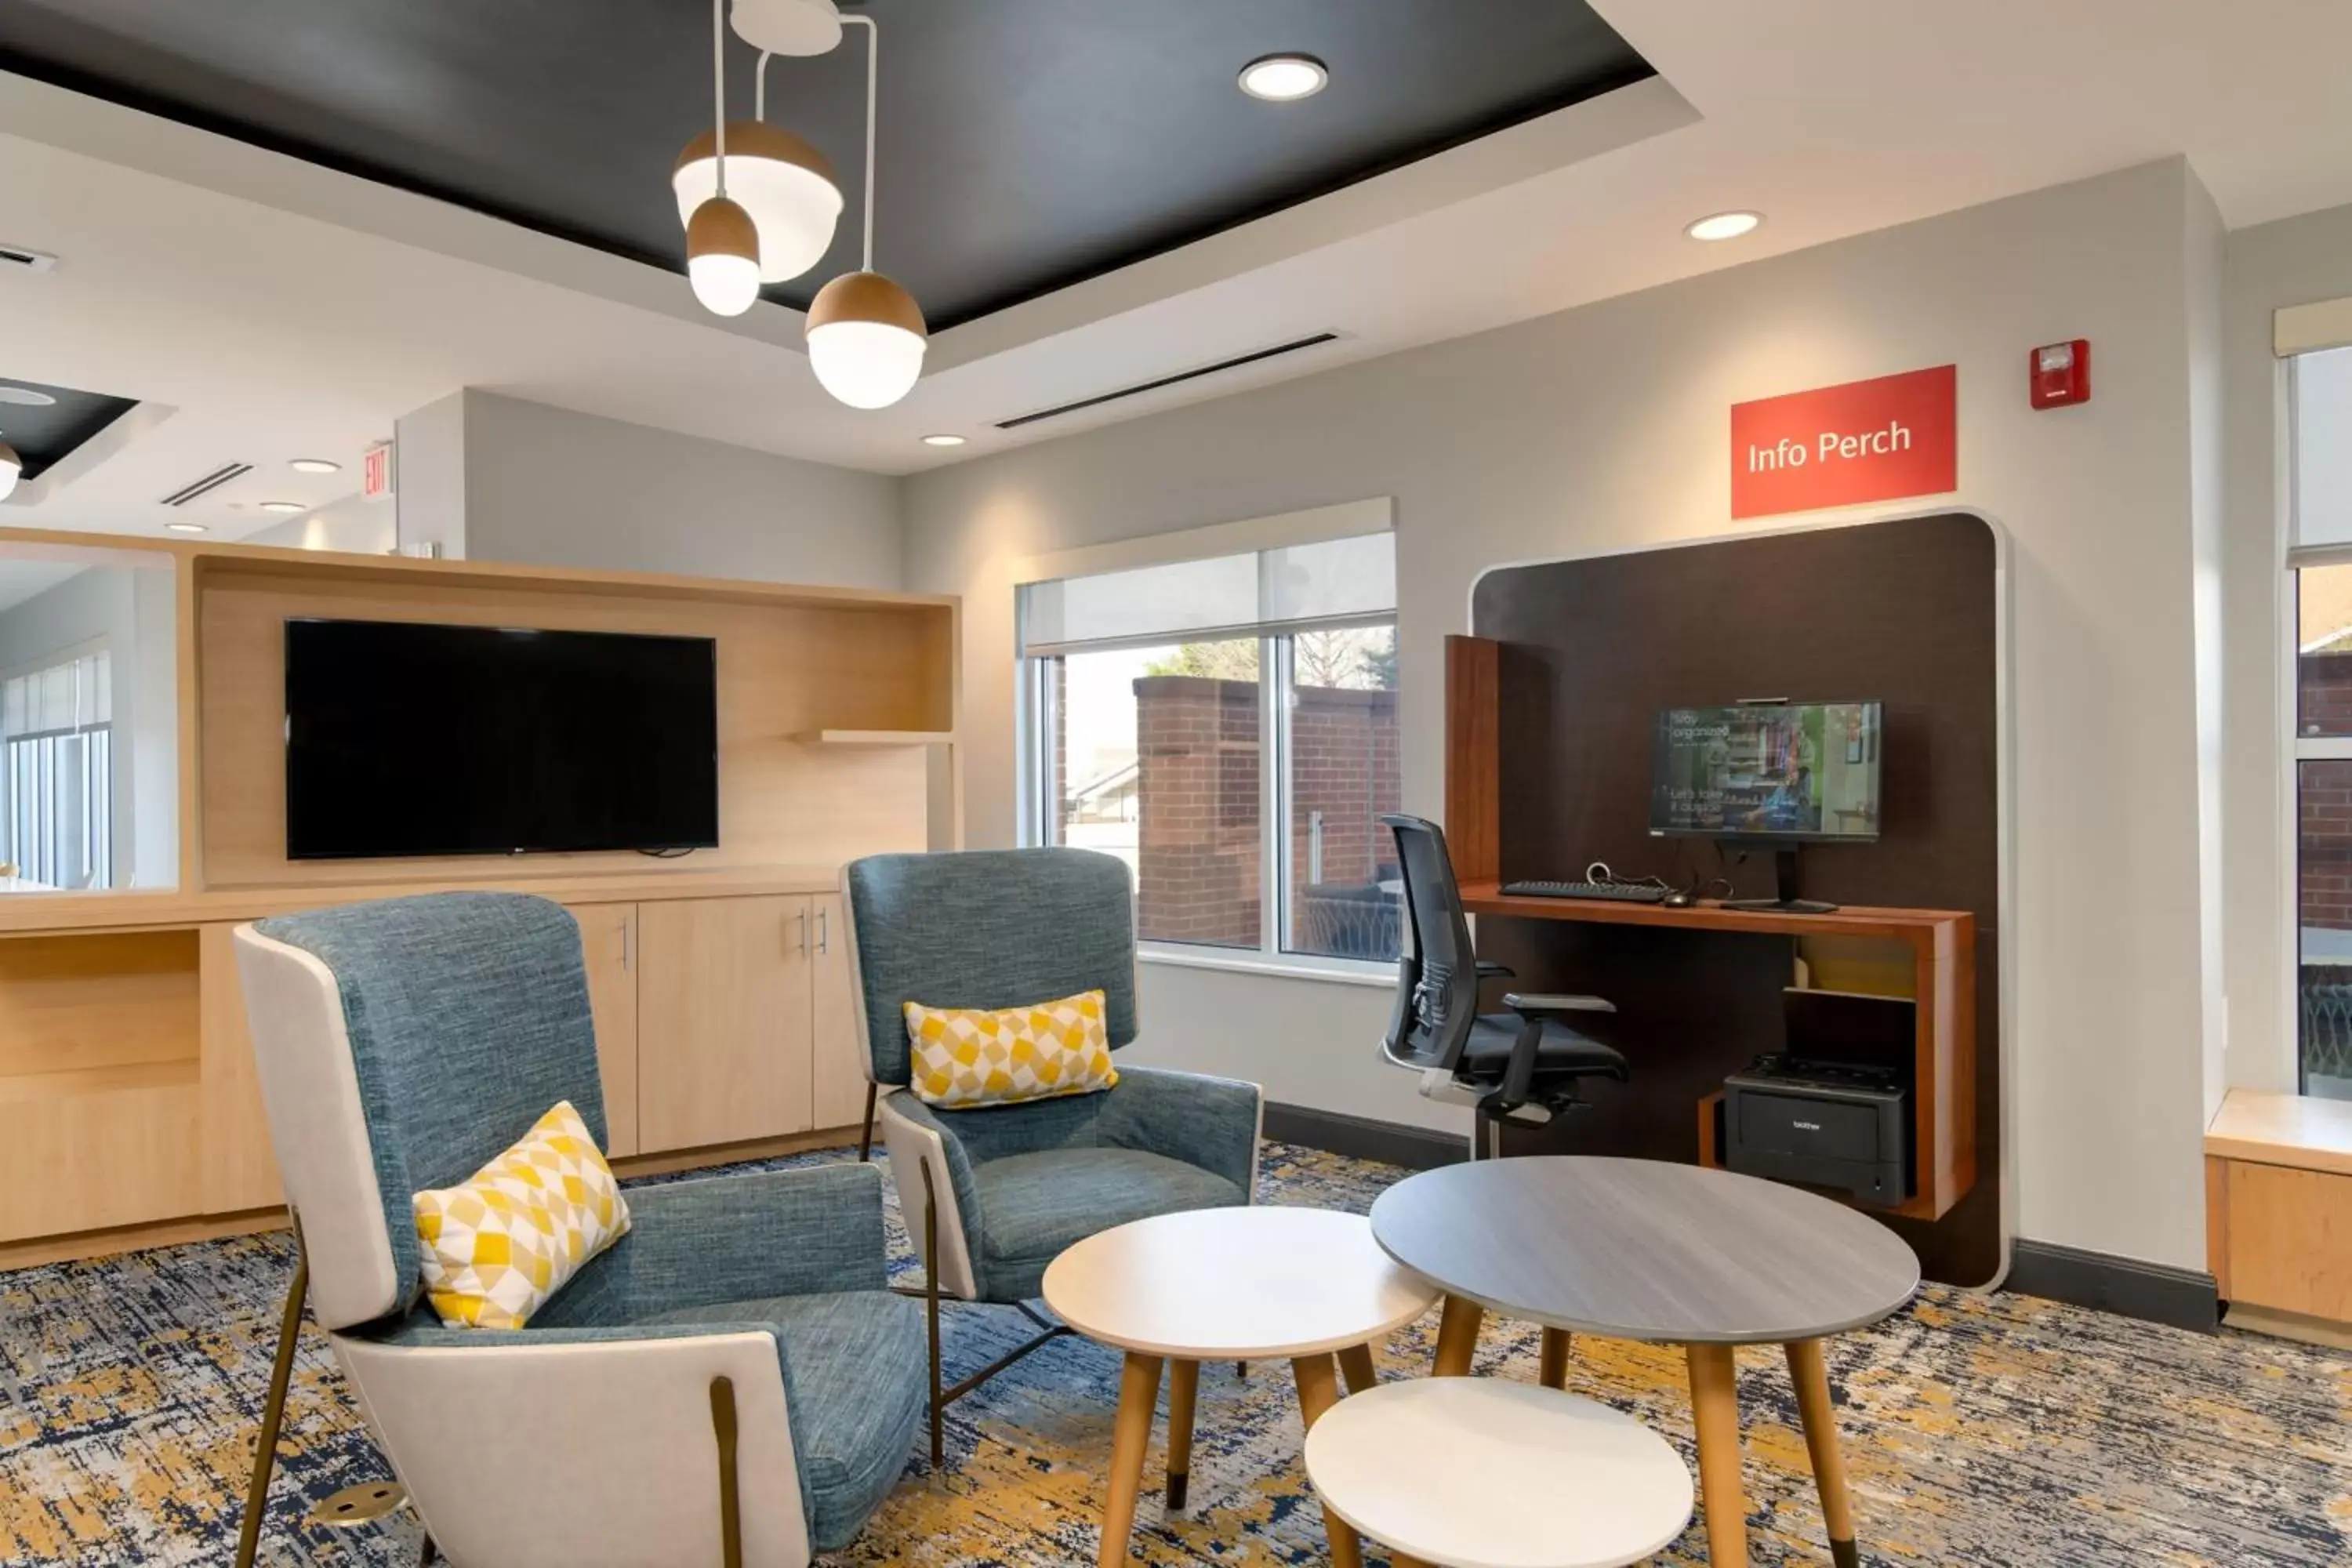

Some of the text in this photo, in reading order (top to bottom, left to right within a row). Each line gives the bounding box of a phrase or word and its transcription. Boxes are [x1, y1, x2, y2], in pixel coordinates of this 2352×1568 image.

[1749, 420, 1911, 473] Info Perch
[365, 449, 385, 495] EXIT
[1793, 1120, 1820, 1130] brother
